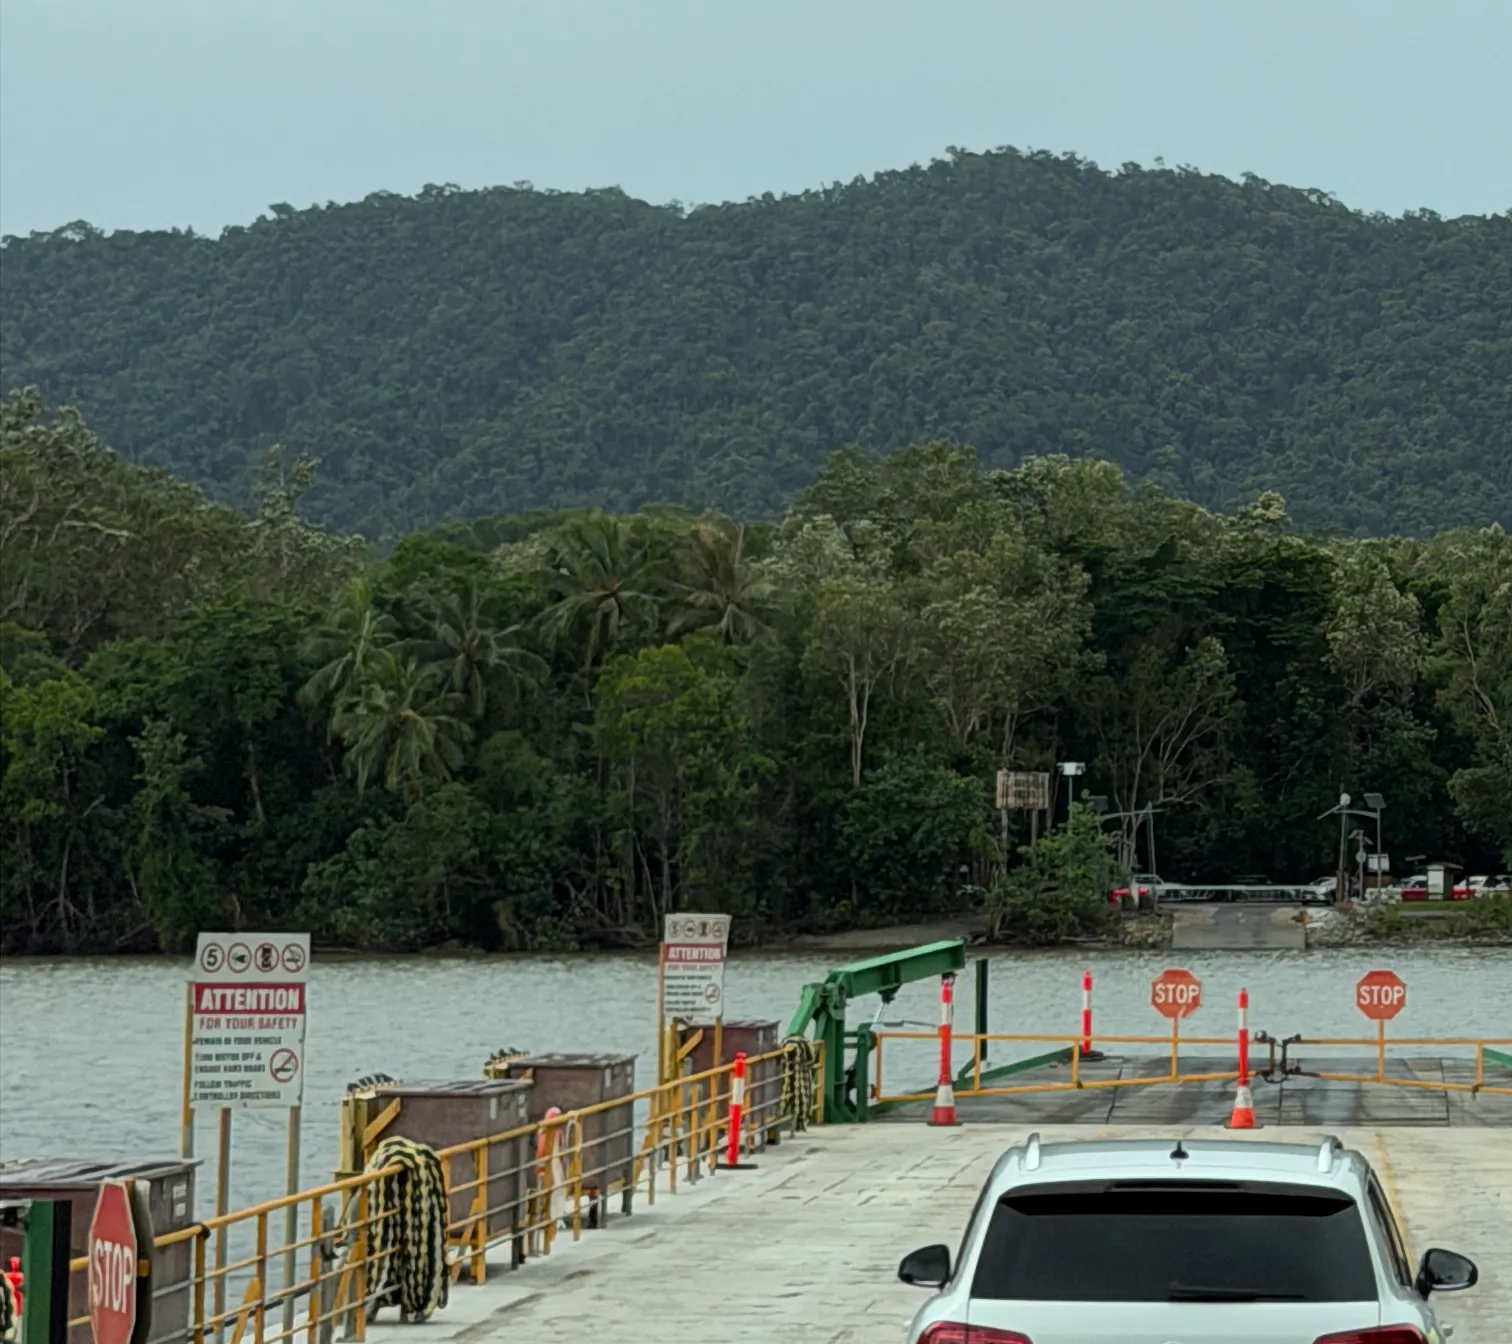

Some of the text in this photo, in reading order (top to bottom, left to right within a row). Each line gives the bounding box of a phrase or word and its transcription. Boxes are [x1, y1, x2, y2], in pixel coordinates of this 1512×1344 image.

[207, 949, 217, 967] 5
[668, 947, 721, 959] ATTENTION
[200, 988, 300, 1011] ATTENTION
[1155, 984, 1200, 1004] STOP
[1359, 985, 1405, 1005] STOP
[199, 1017, 298, 1030] FOR YOUR SAFETY
[92, 1238, 134, 1314] STOP
